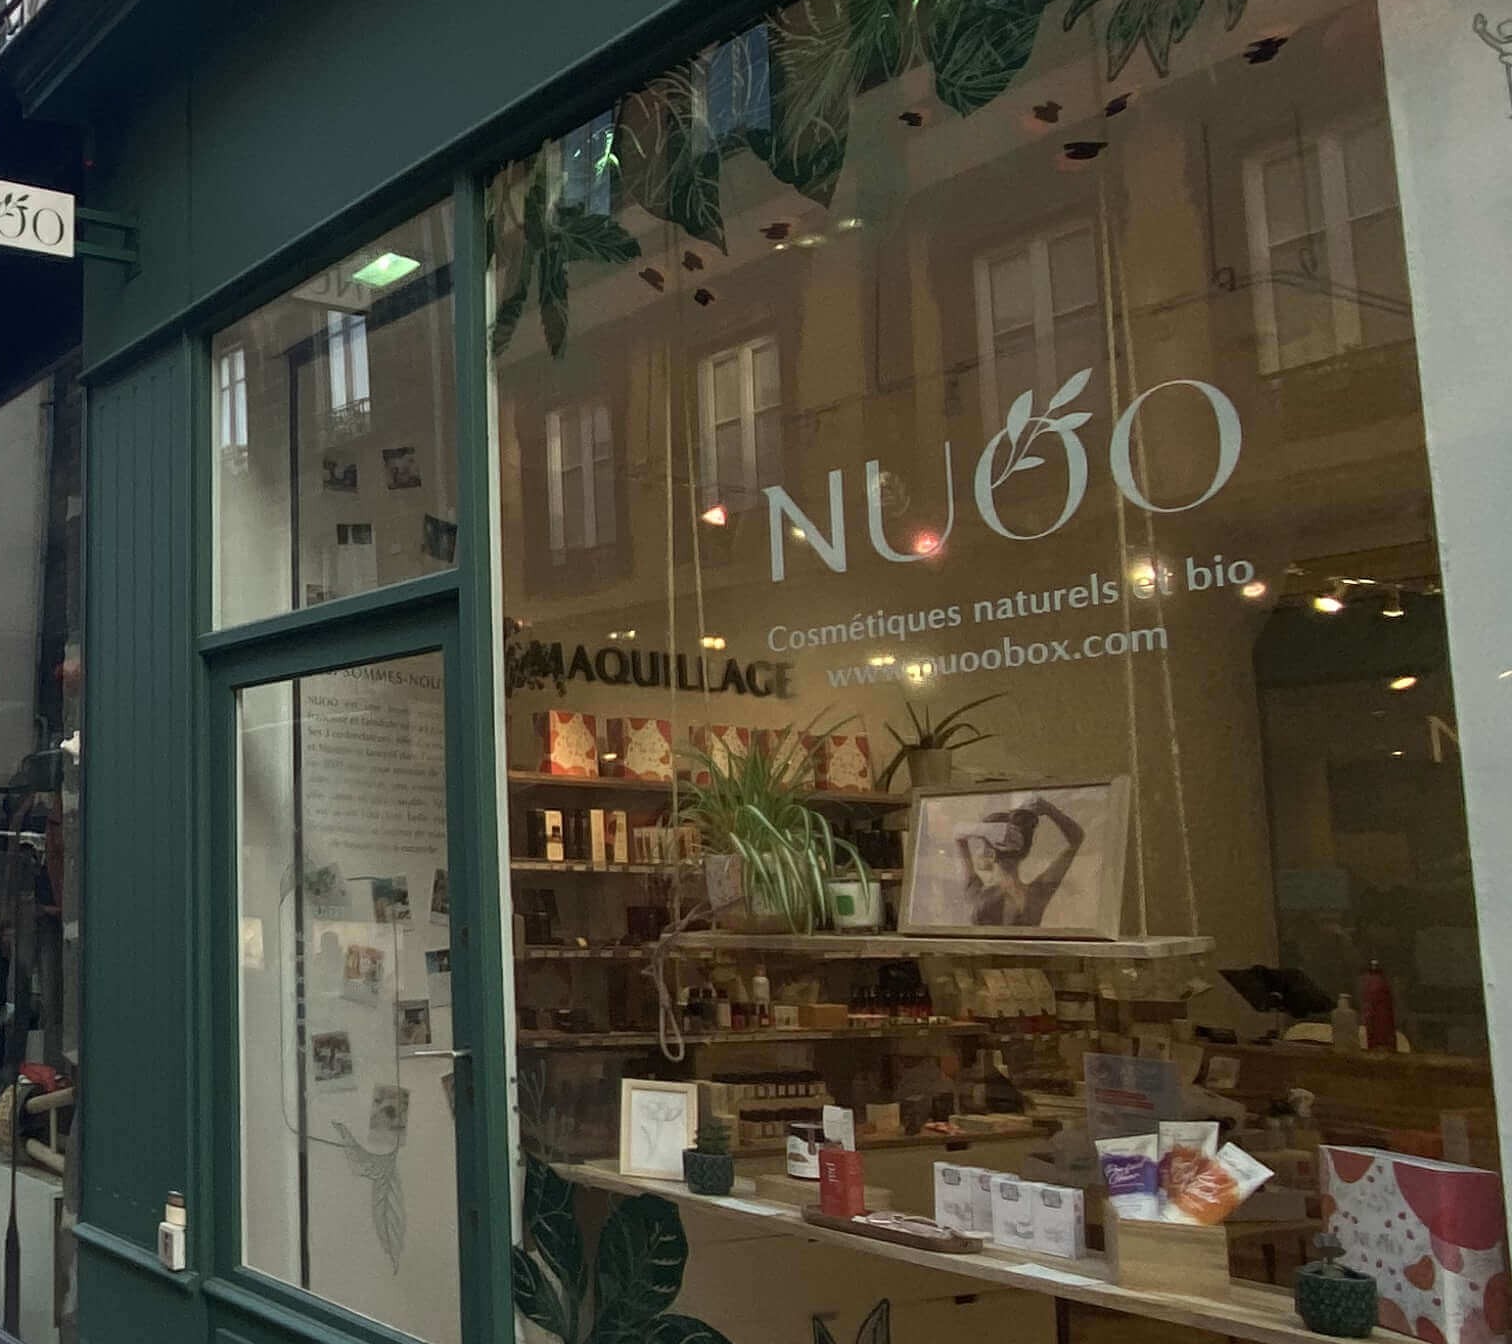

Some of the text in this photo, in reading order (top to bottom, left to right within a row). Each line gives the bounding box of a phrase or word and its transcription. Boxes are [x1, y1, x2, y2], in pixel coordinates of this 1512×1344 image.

[762, 367, 1243, 582] NUOO
[767, 606, 961, 653] Cosmétiques
[974, 573, 1119, 623] naturels
[1186, 555, 1255, 591] bio
